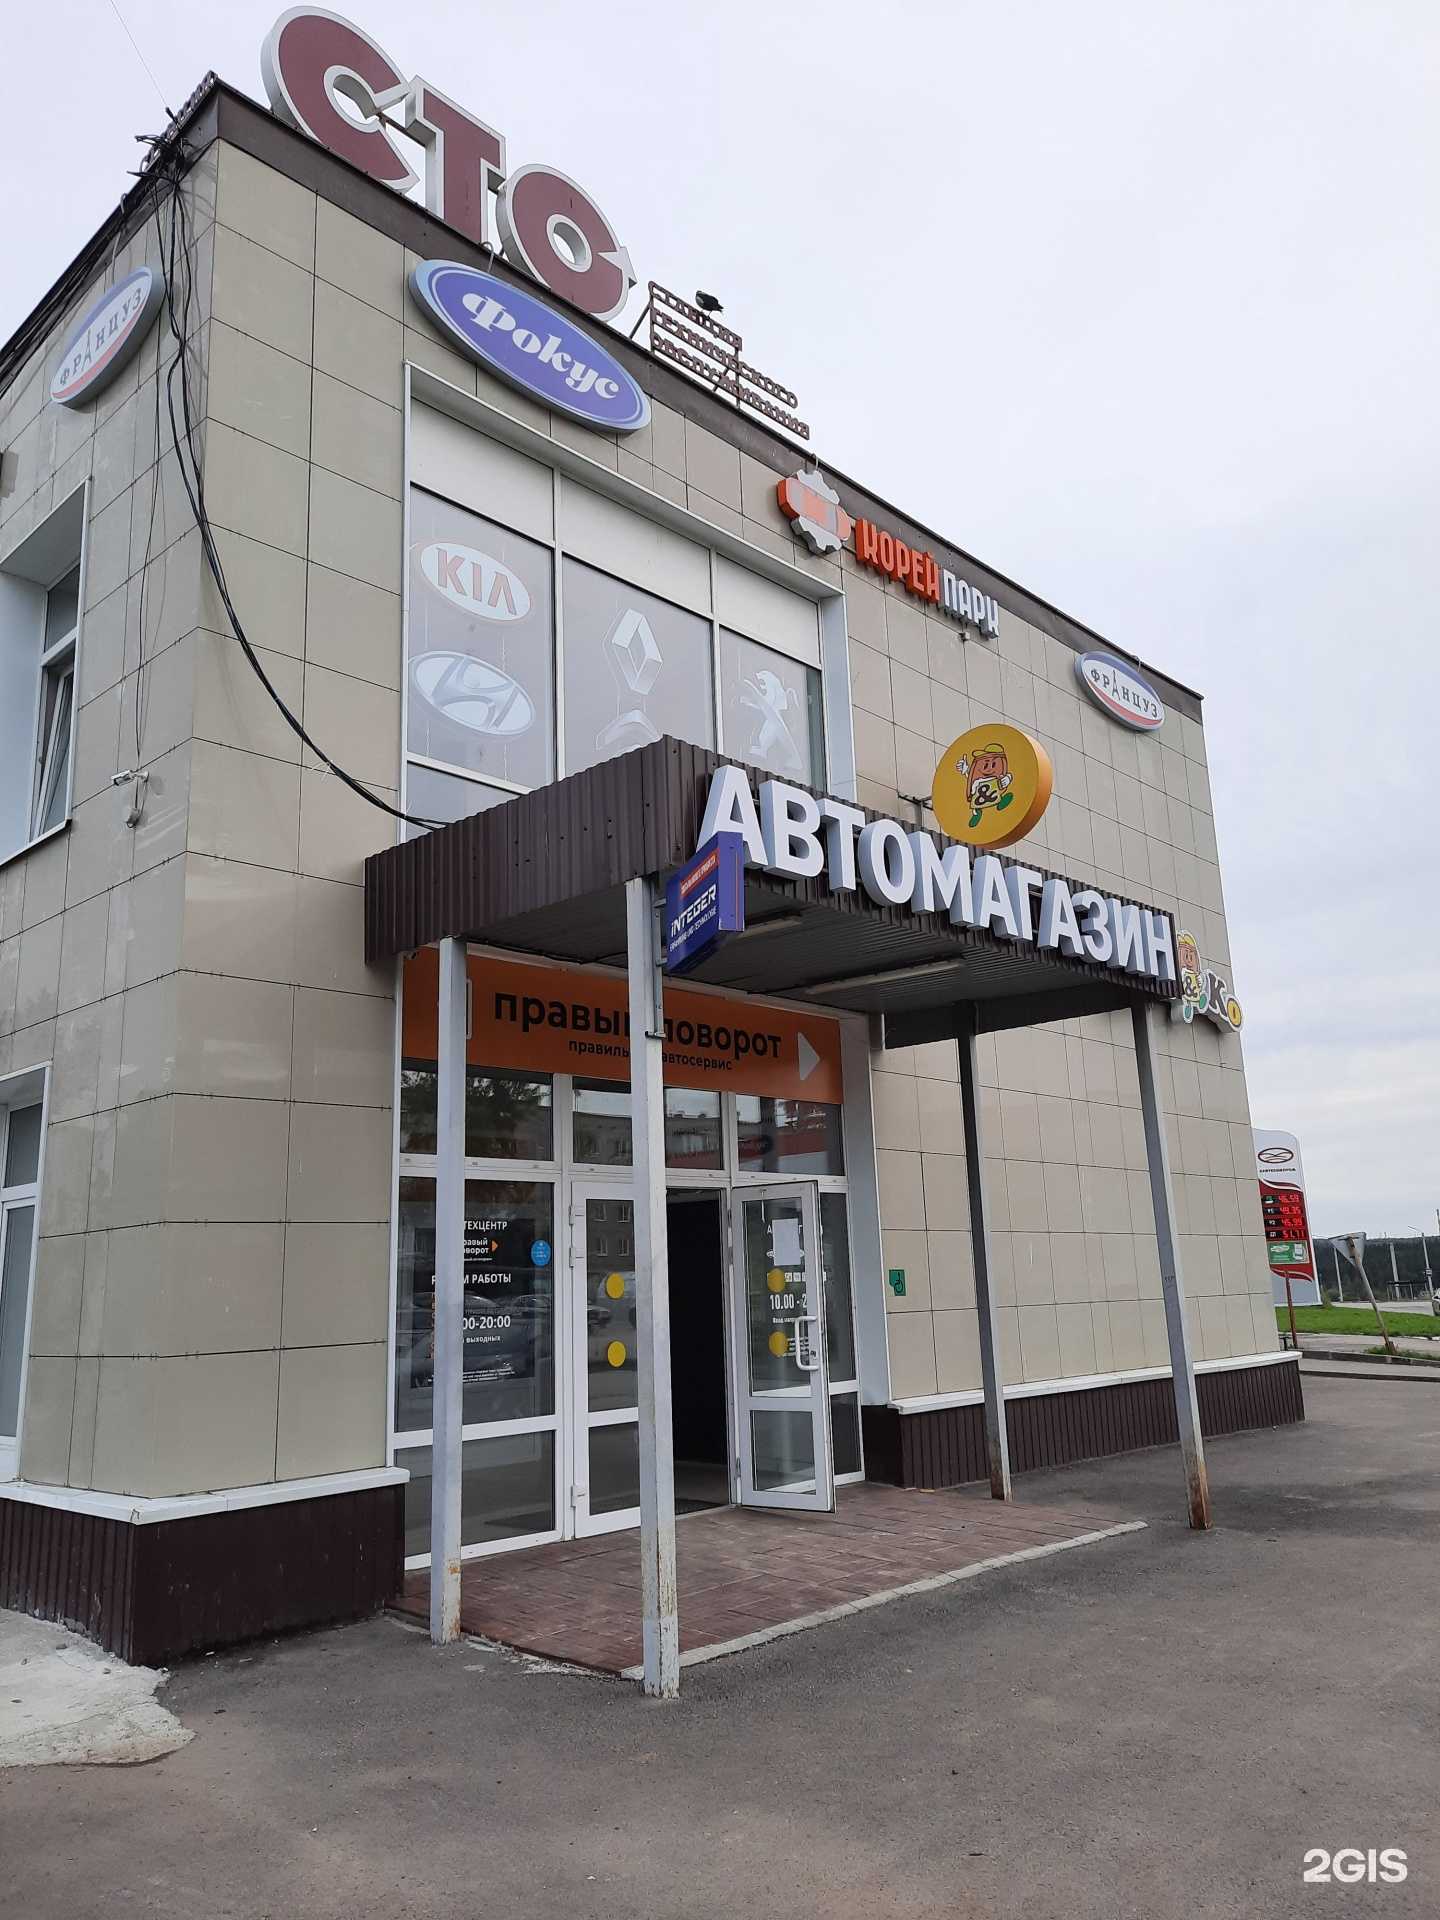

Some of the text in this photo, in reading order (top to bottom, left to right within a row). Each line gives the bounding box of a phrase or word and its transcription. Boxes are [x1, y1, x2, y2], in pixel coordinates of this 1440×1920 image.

[261, 5, 637, 322] СТО
[60, 287, 142, 386] ФРАНЦУЗ
[461, 291, 620, 400] Фокус
[436, 547, 518, 617] KIA
[1090, 667, 1158, 718] ФРАНЦУЗ
[696, 764, 1177, 983] АВТОМАГАЗИН
[494, 993, 630, 1037] правы
[568, 1041, 733, 1071] правиль автосервис
[471, 1273, 512, 1284] РАБОТЫ
[770, 1293, 795, 1310] 10.00
[463, 1315, 511, 1330] 00-20:00
